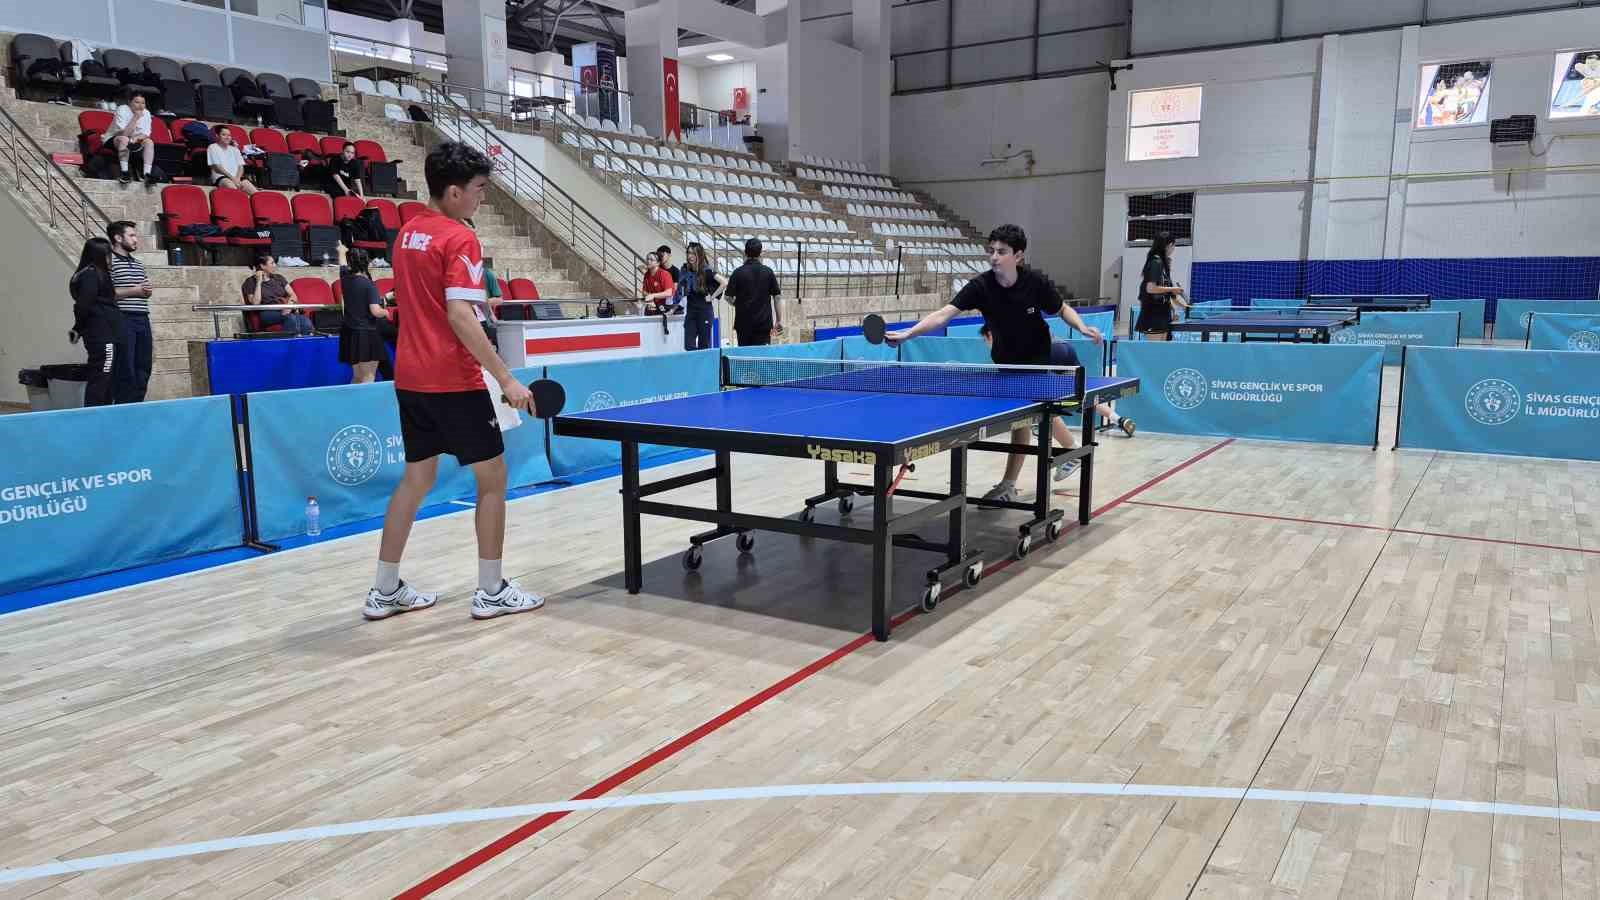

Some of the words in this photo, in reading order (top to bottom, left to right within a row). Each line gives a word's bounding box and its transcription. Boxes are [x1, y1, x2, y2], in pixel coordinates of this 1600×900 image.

[1211, 378, 1237, 389] SİVAS
[1240, 380, 1280, 392] GENÇLİK
[1282, 383, 1295, 392] VE
[1296, 383, 1323, 393] SPOR
[1220, 391, 1283, 402] MÜDÜRLÜĞÜ
[1526, 392, 1560, 403] SİVAS
[1563, 395, 1600, 407] GENÇ
[1525, 405, 1535, 416] İL
[1537, 405, 1599, 418] MÜDÜRLÜ
[386, 433, 403, 448] SİV
[807, 444, 877, 465] Yasaka
[1, 477, 79, 501] GENÇLİK
[81, 475, 105, 489] VE
[107, 468, 152, 487] SPOR
[0, 495, 88, 524] DÜRLÜĞÜ
